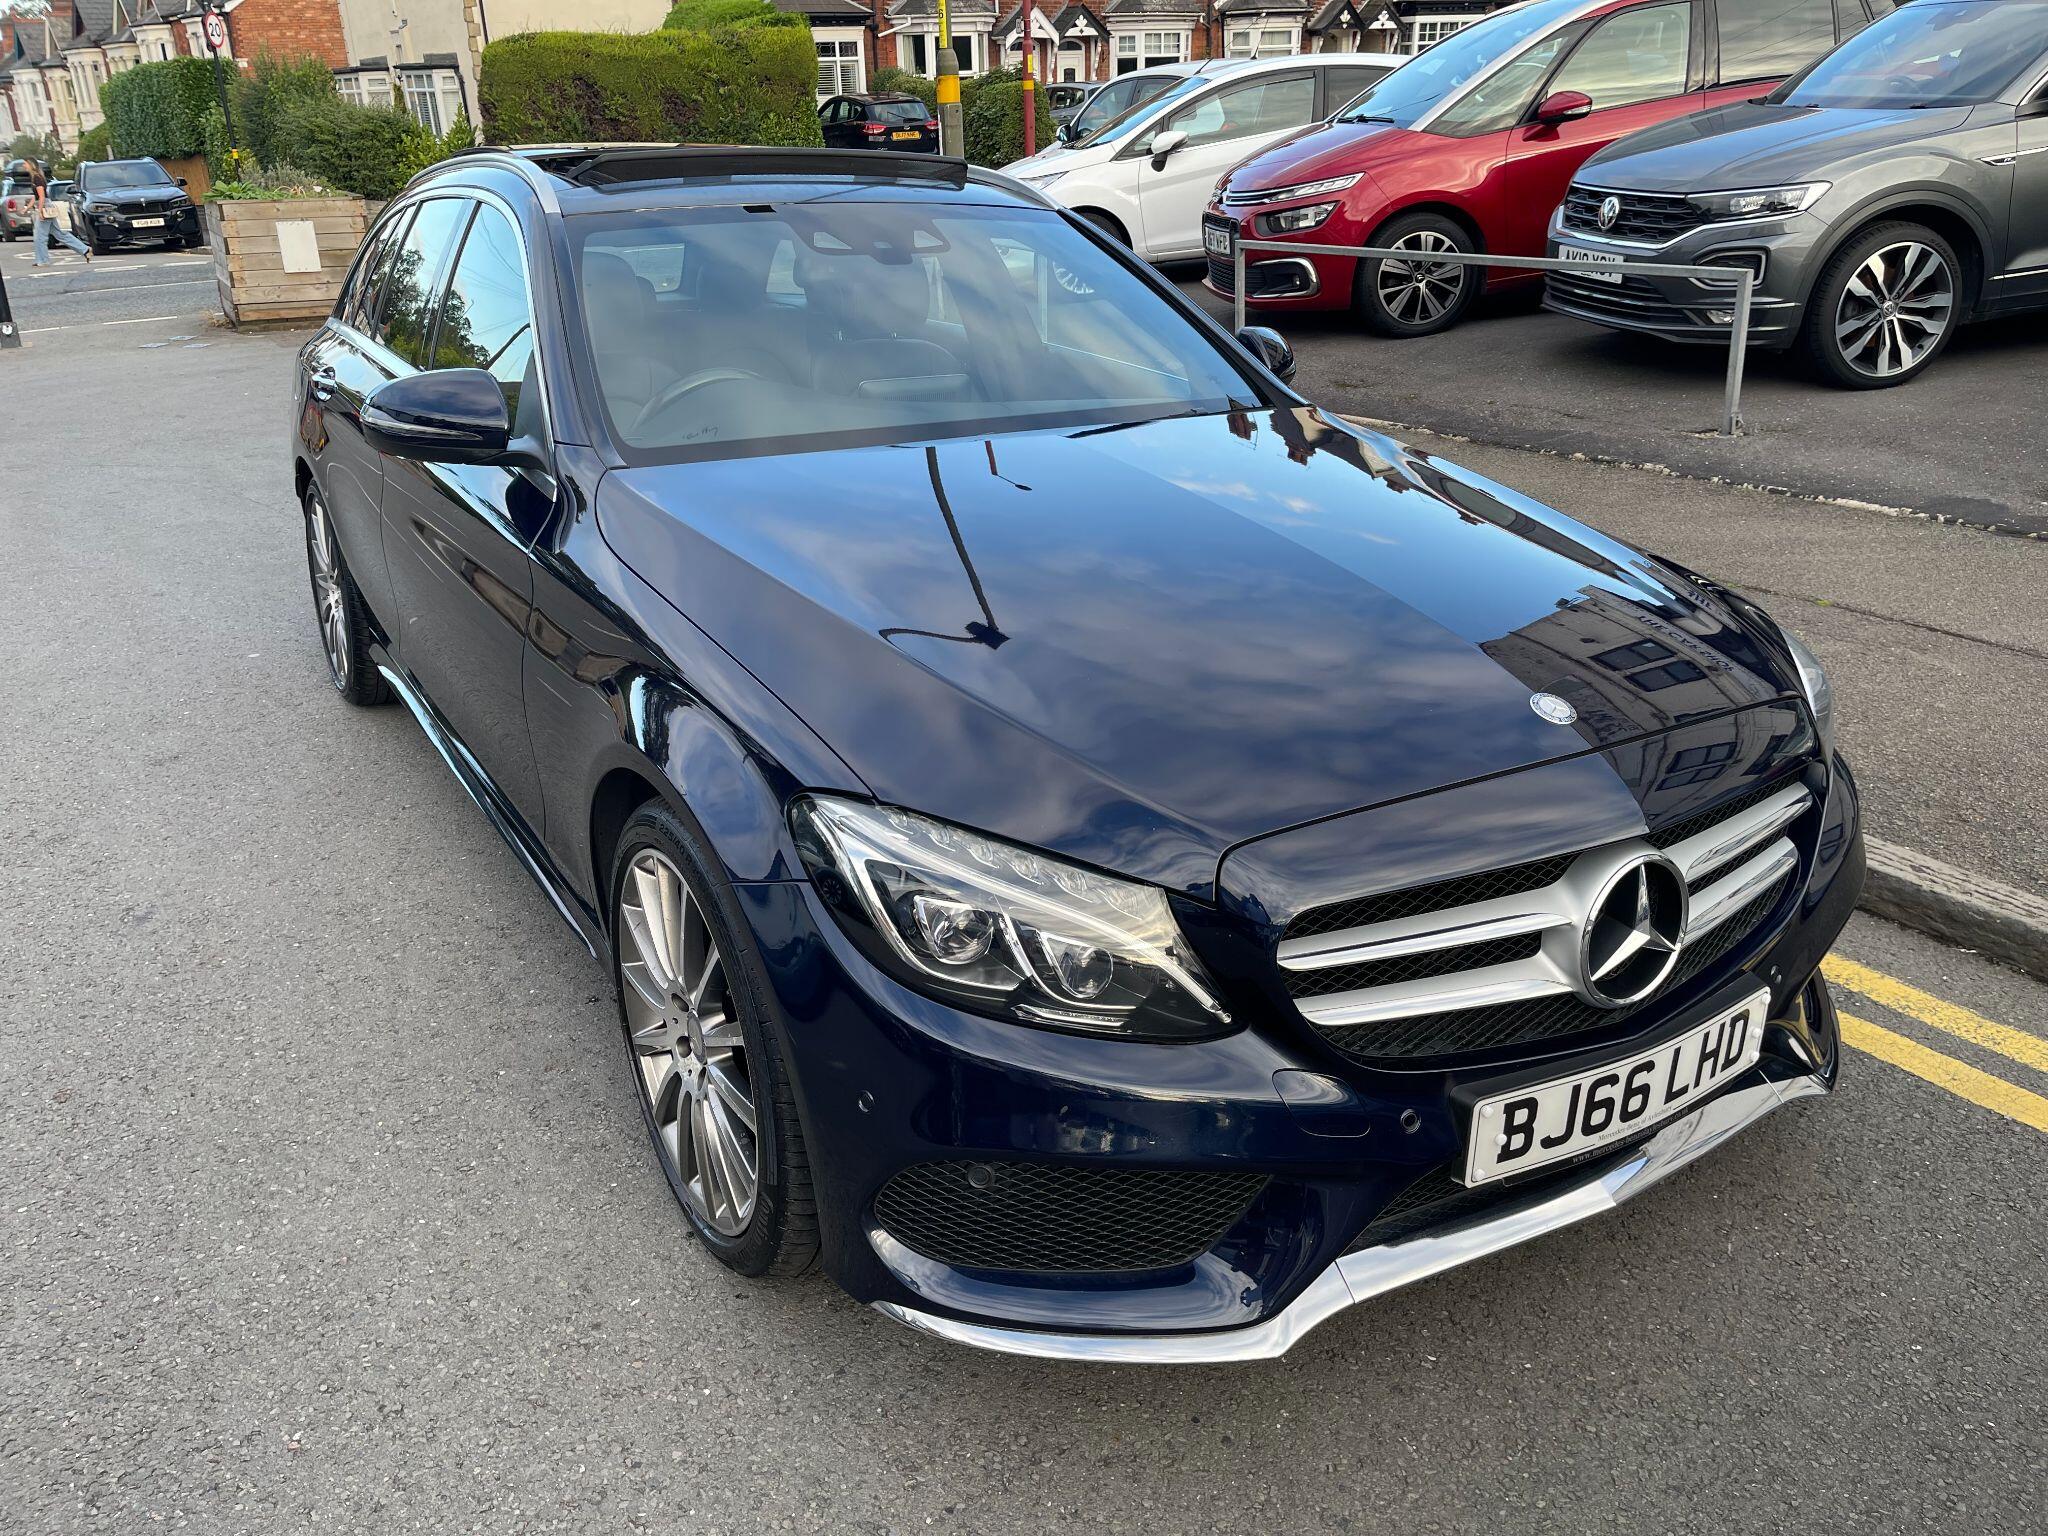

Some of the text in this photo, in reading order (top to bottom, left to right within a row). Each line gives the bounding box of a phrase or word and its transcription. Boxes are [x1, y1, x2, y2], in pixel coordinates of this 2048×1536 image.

[208, 22, 221, 37] 20
[1496, 1008, 1751, 1164] BJ66 LHD
